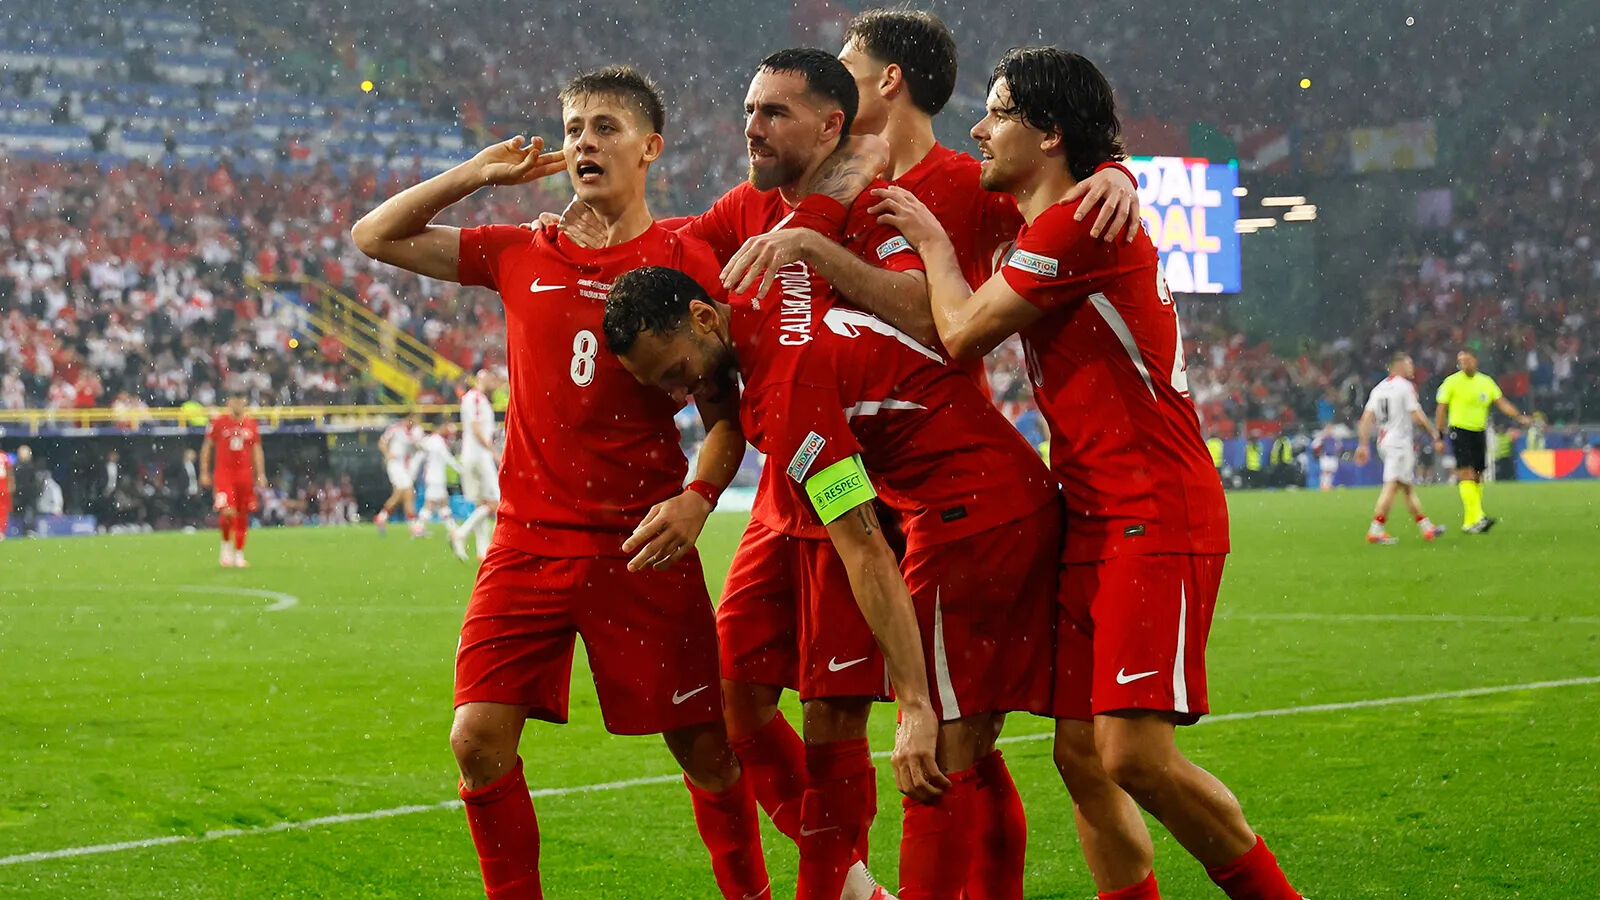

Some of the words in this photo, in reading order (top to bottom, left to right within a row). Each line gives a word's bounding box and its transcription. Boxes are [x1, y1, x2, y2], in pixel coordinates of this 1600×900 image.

[1129, 160, 1222, 207] OAL
[570, 329, 598, 387] 8
[824, 475, 862, 501] RESPECT
